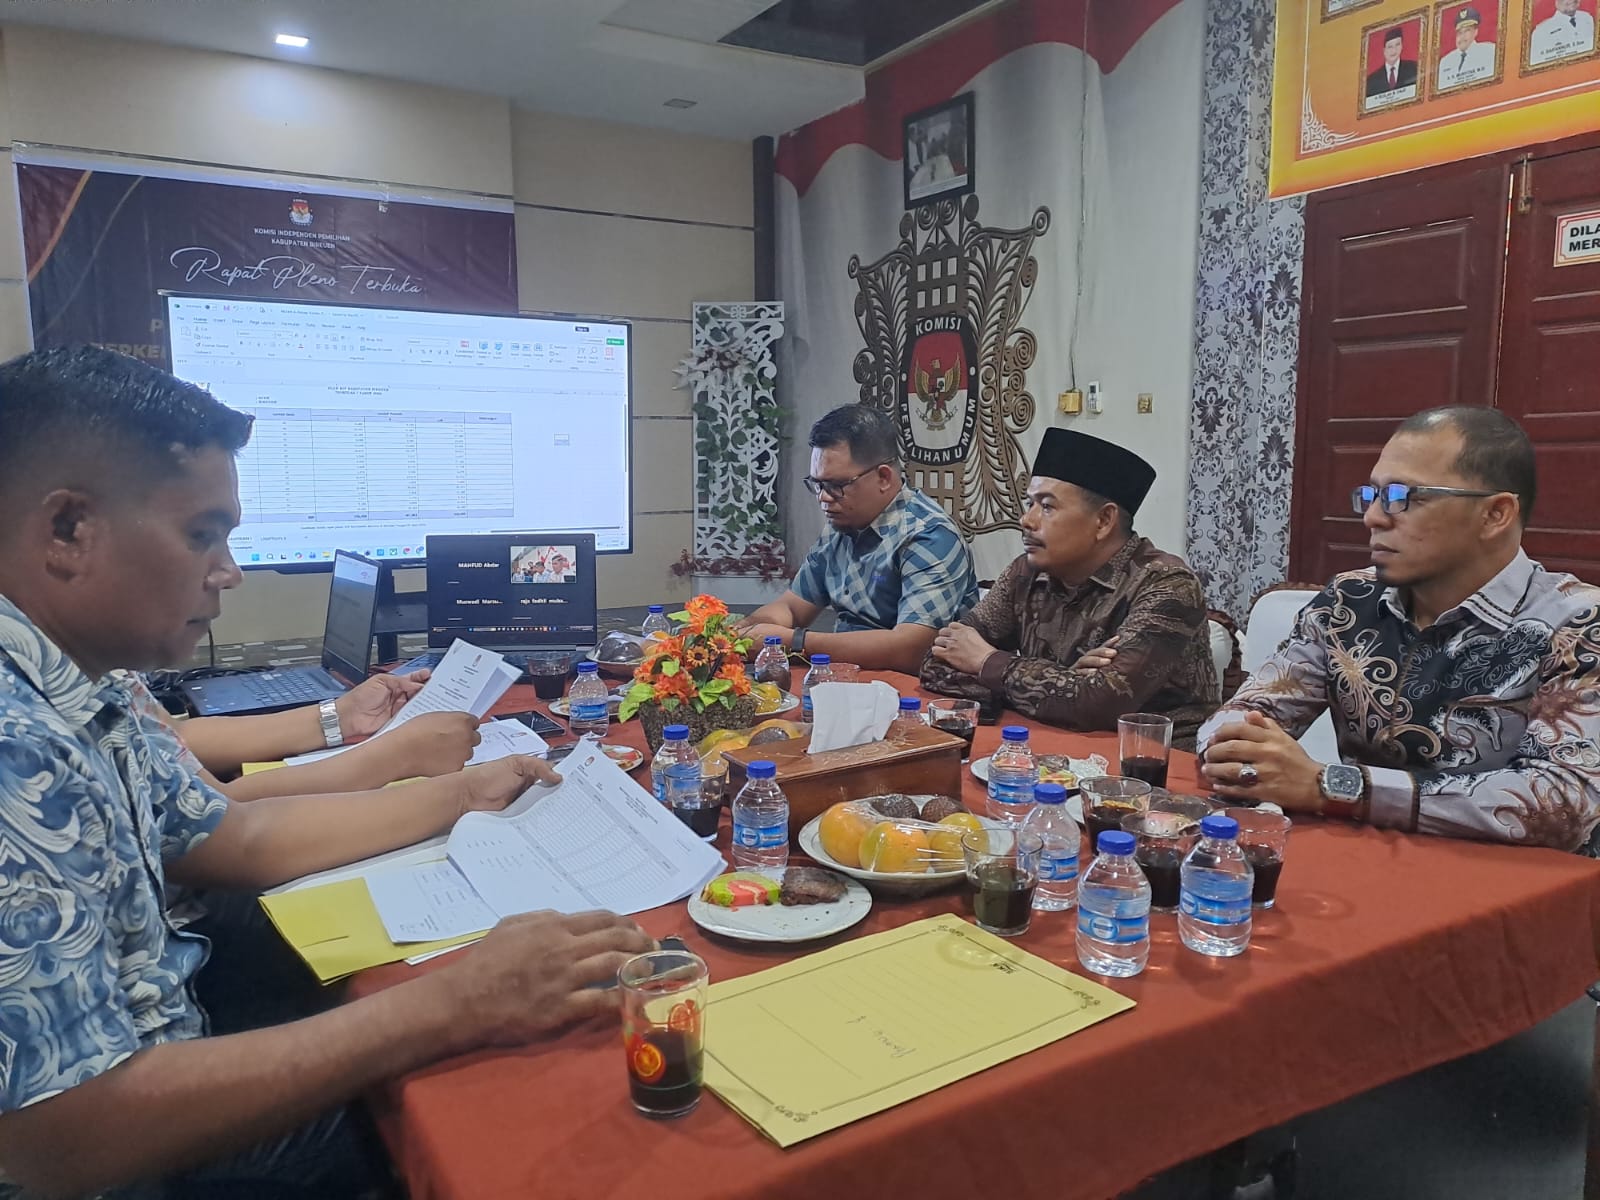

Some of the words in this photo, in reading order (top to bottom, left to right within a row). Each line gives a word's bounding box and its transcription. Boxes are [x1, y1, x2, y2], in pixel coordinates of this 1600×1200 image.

[254, 227, 277, 236] KOMISI
[277, 229, 317, 239] INDEPENDEN
[271, 238, 308, 247] KABUPATEN
[170, 247, 268, 287] Rapat
[262, 255, 339, 289] Pleno
[340, 264, 423, 295] Terbuka
[915, 316, 962, 336] KOMISI
